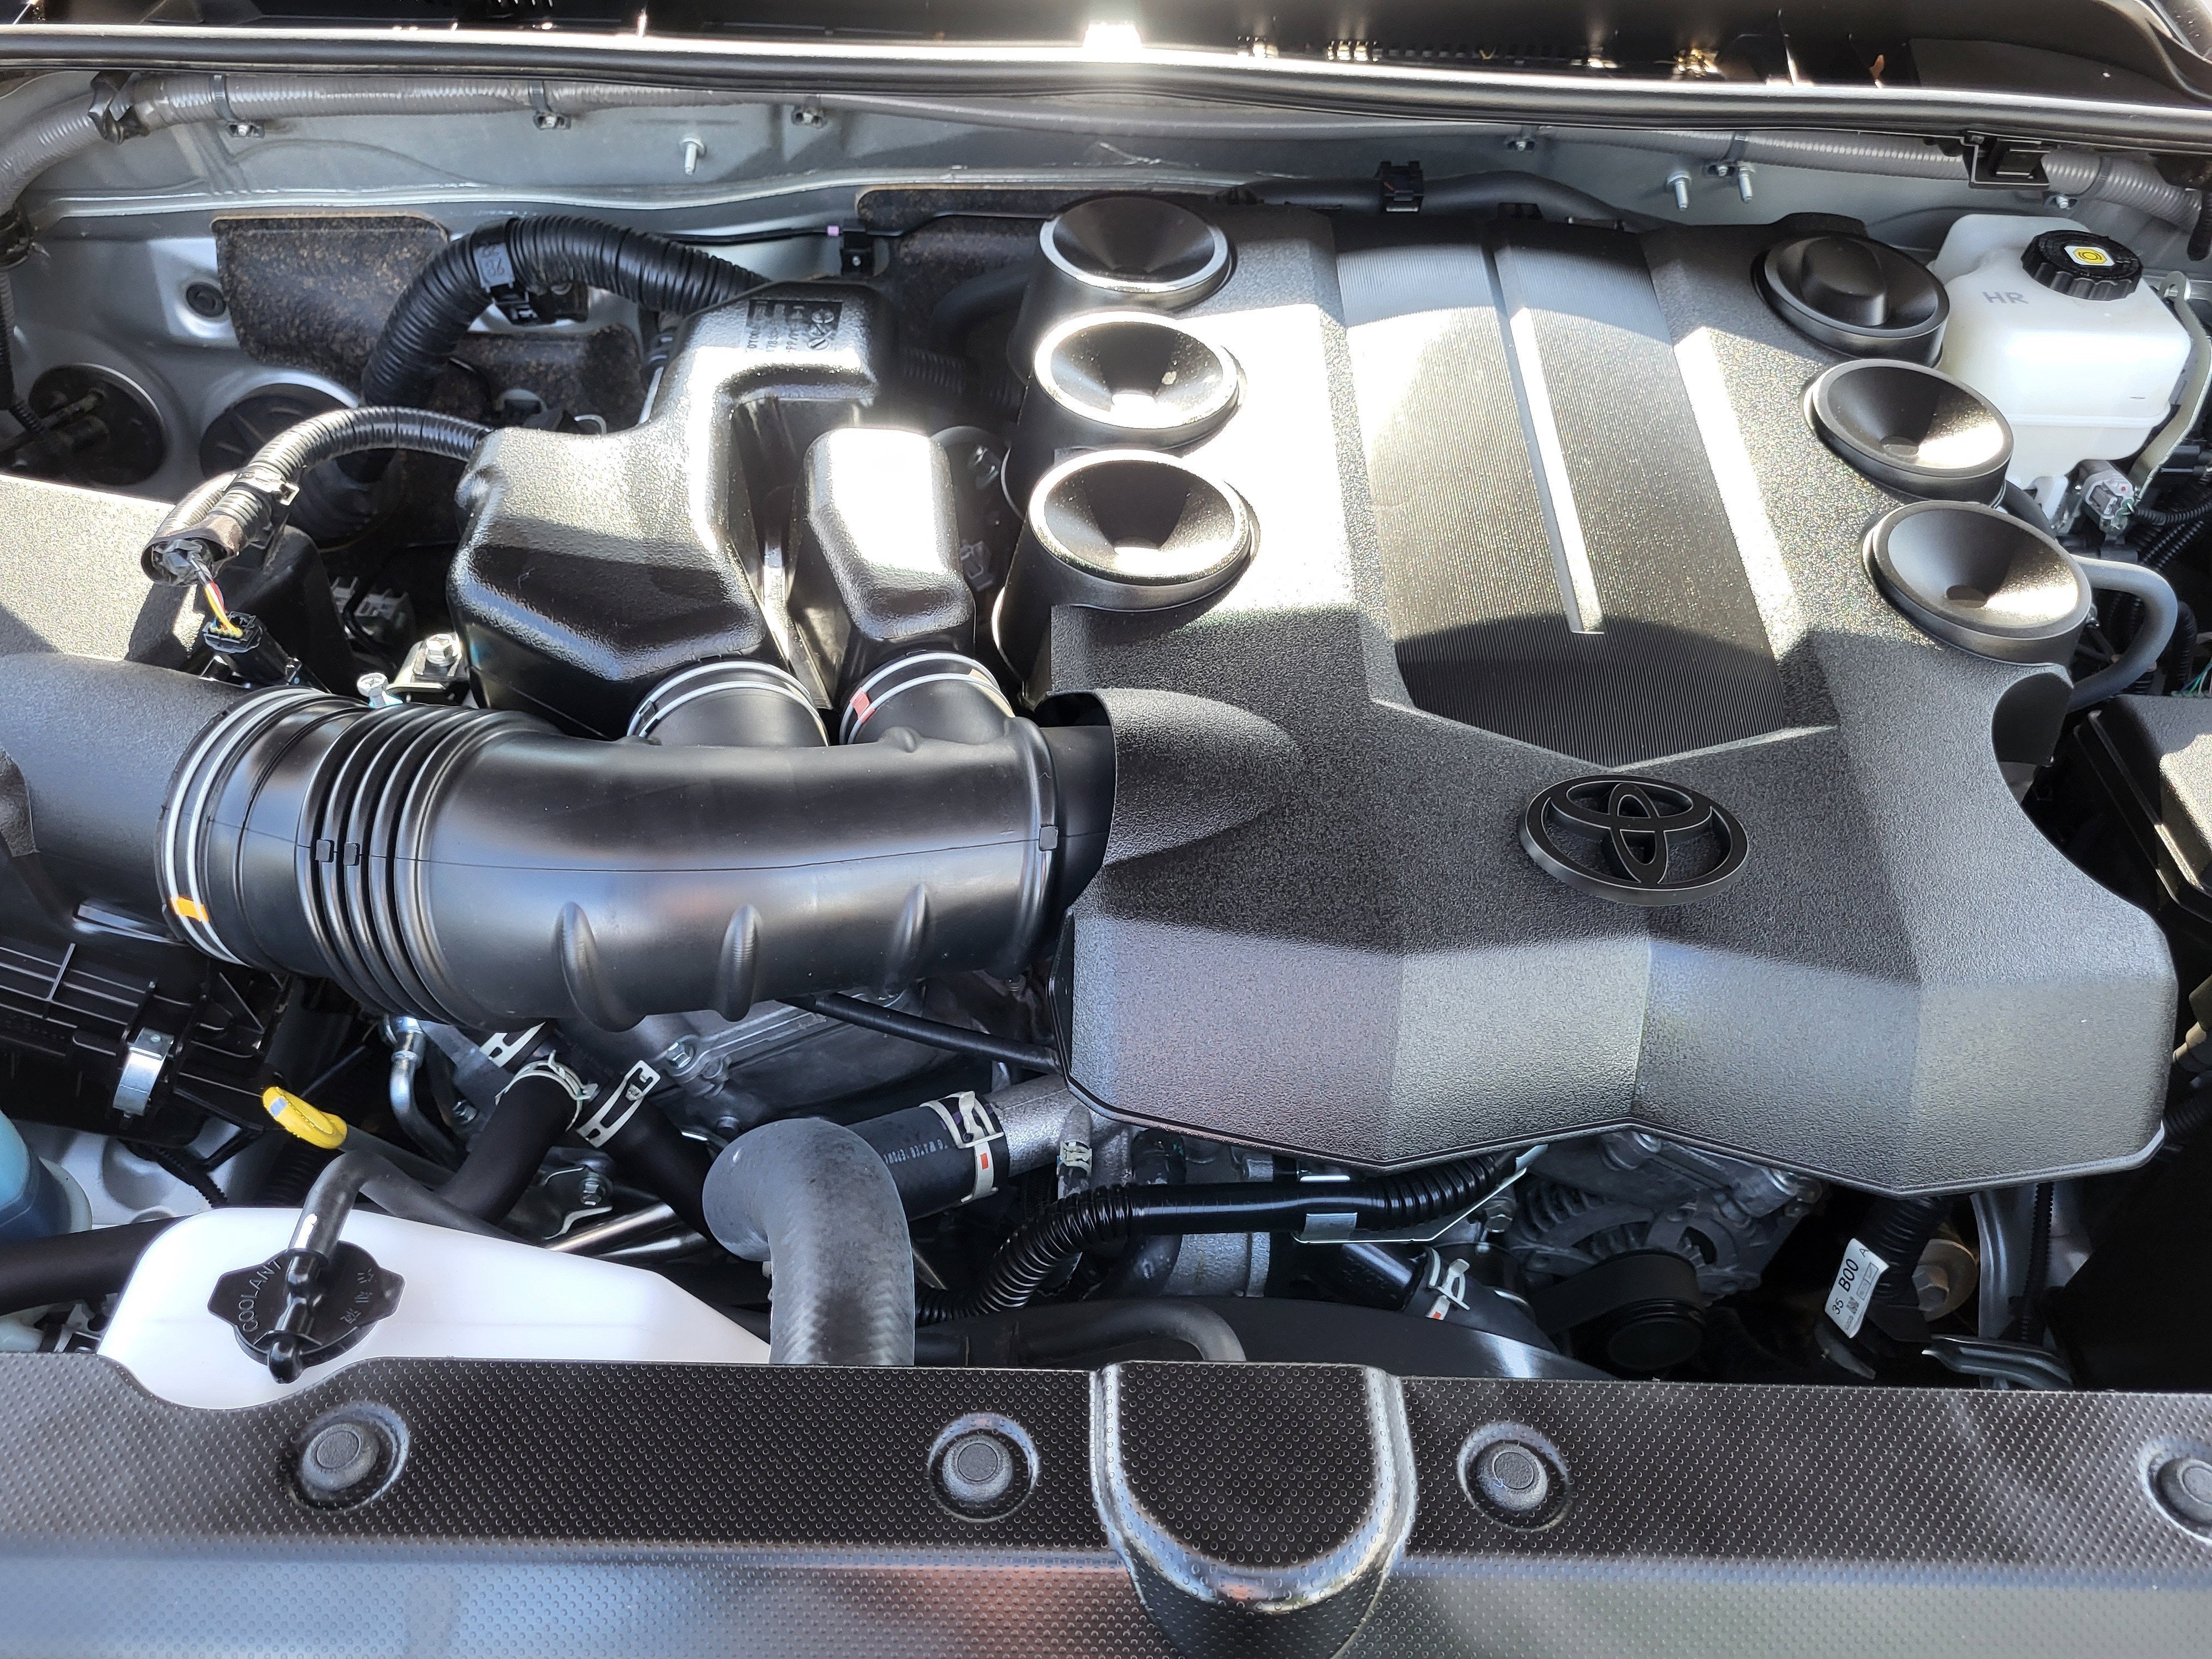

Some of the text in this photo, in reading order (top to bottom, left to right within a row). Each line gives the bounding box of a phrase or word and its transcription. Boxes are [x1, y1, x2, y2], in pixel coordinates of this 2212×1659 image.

[1982, 291, 2029, 304] HR
[238, 1256, 281, 1332] COOLANT
[1832, 1297, 1844, 1314] 35
[1859, 1248, 1869, 1258] A
